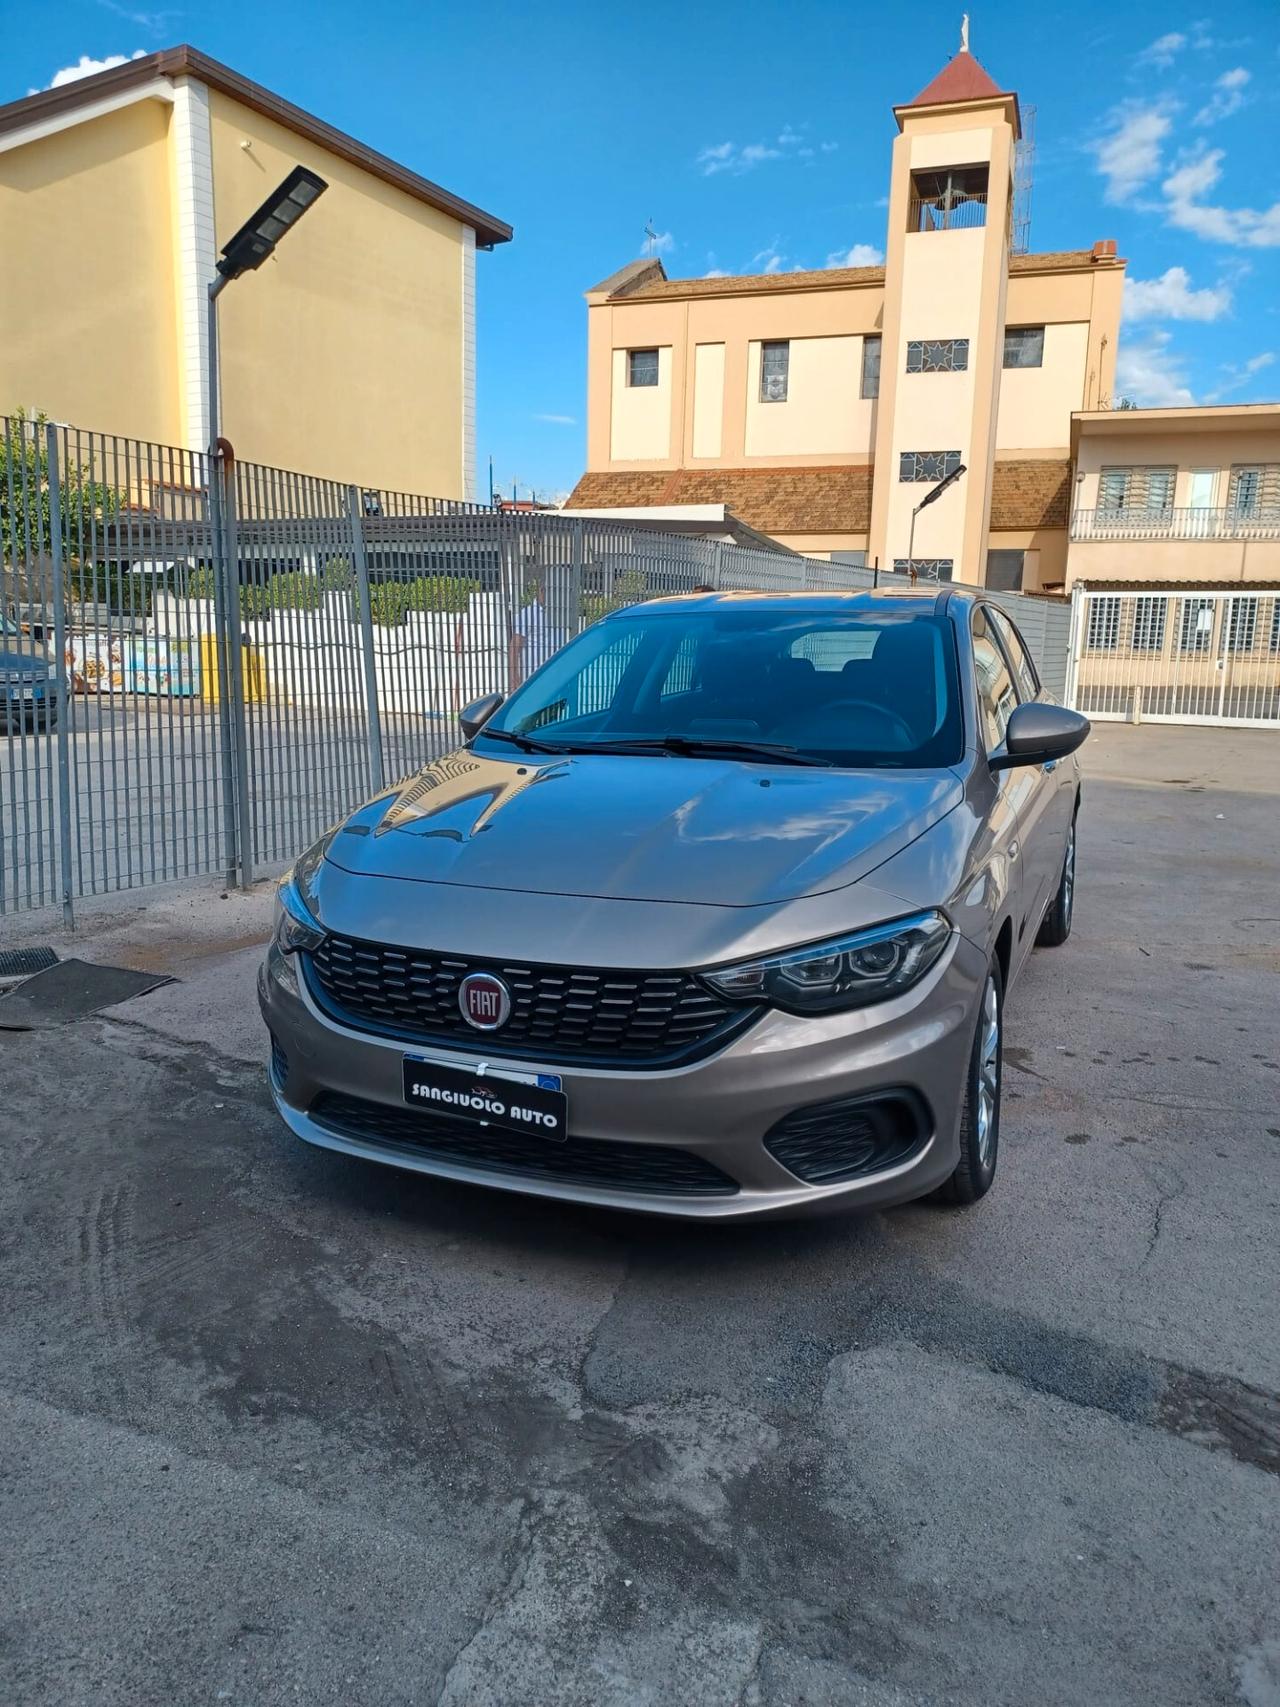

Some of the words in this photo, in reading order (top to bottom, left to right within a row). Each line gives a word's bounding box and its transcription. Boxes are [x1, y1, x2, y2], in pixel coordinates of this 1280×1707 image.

[469, 989, 499, 1017] FIAT
[412, 1083, 505, 1115] SANGIUOLO
[510, 1106, 558, 1128] AUTO
